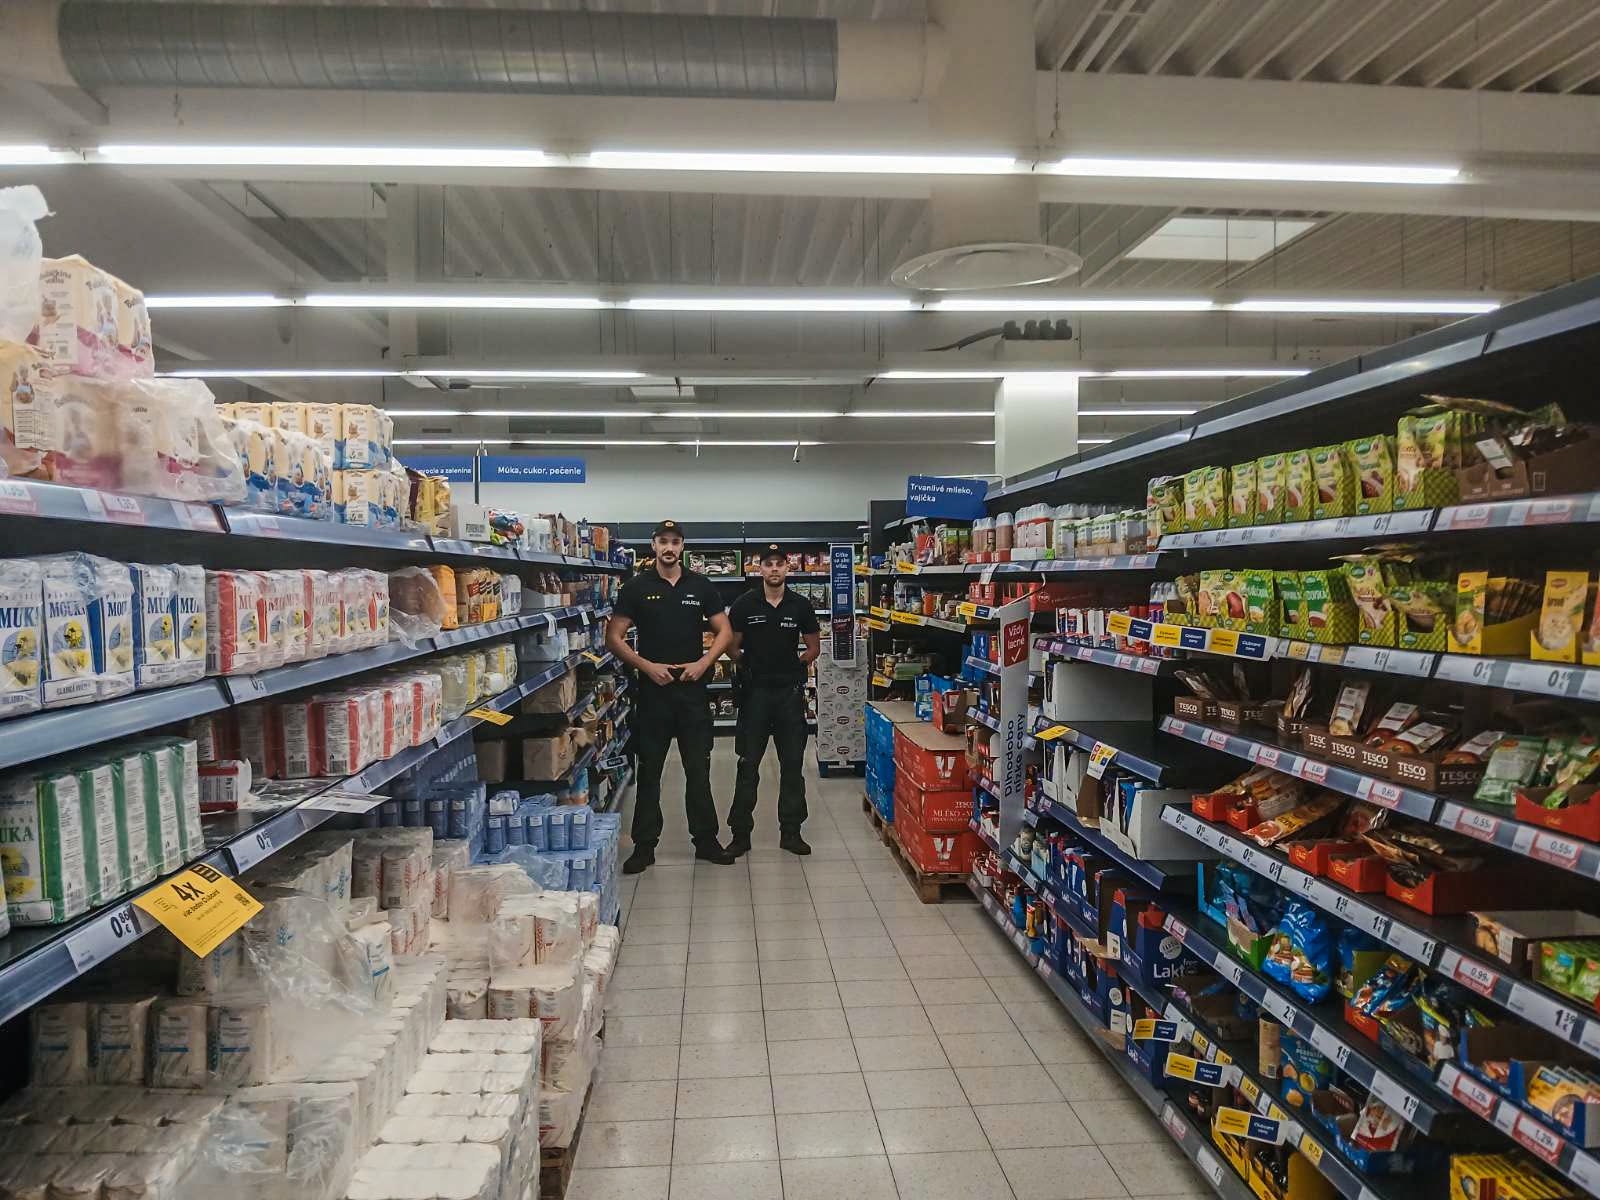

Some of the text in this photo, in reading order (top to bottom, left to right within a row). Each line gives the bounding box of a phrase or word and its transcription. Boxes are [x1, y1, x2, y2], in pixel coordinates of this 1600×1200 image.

[446, 466, 472, 474] zelenina
[498, 466, 582, 476] Múka, cukor, pečenie
[910, 483, 973, 496] Trvanlivé mlieko,
[910, 494, 936, 502] vajíčka
[1008, 624, 1024, 638] Vždy
[1008, 636, 1024, 650] lacné
[1179, 702, 1198, 710] TESCO
[1220, 707, 1236, 717] TESCO
[1014, 714, 1026, 794] nízke ceny
[1332, 742, 1356, 754] TESCO
[1004, 720, 1014, 798] Dlhodobo
[1362, 751, 1389, 764] TESCO
[1398, 762, 1426, 776] TESCO
